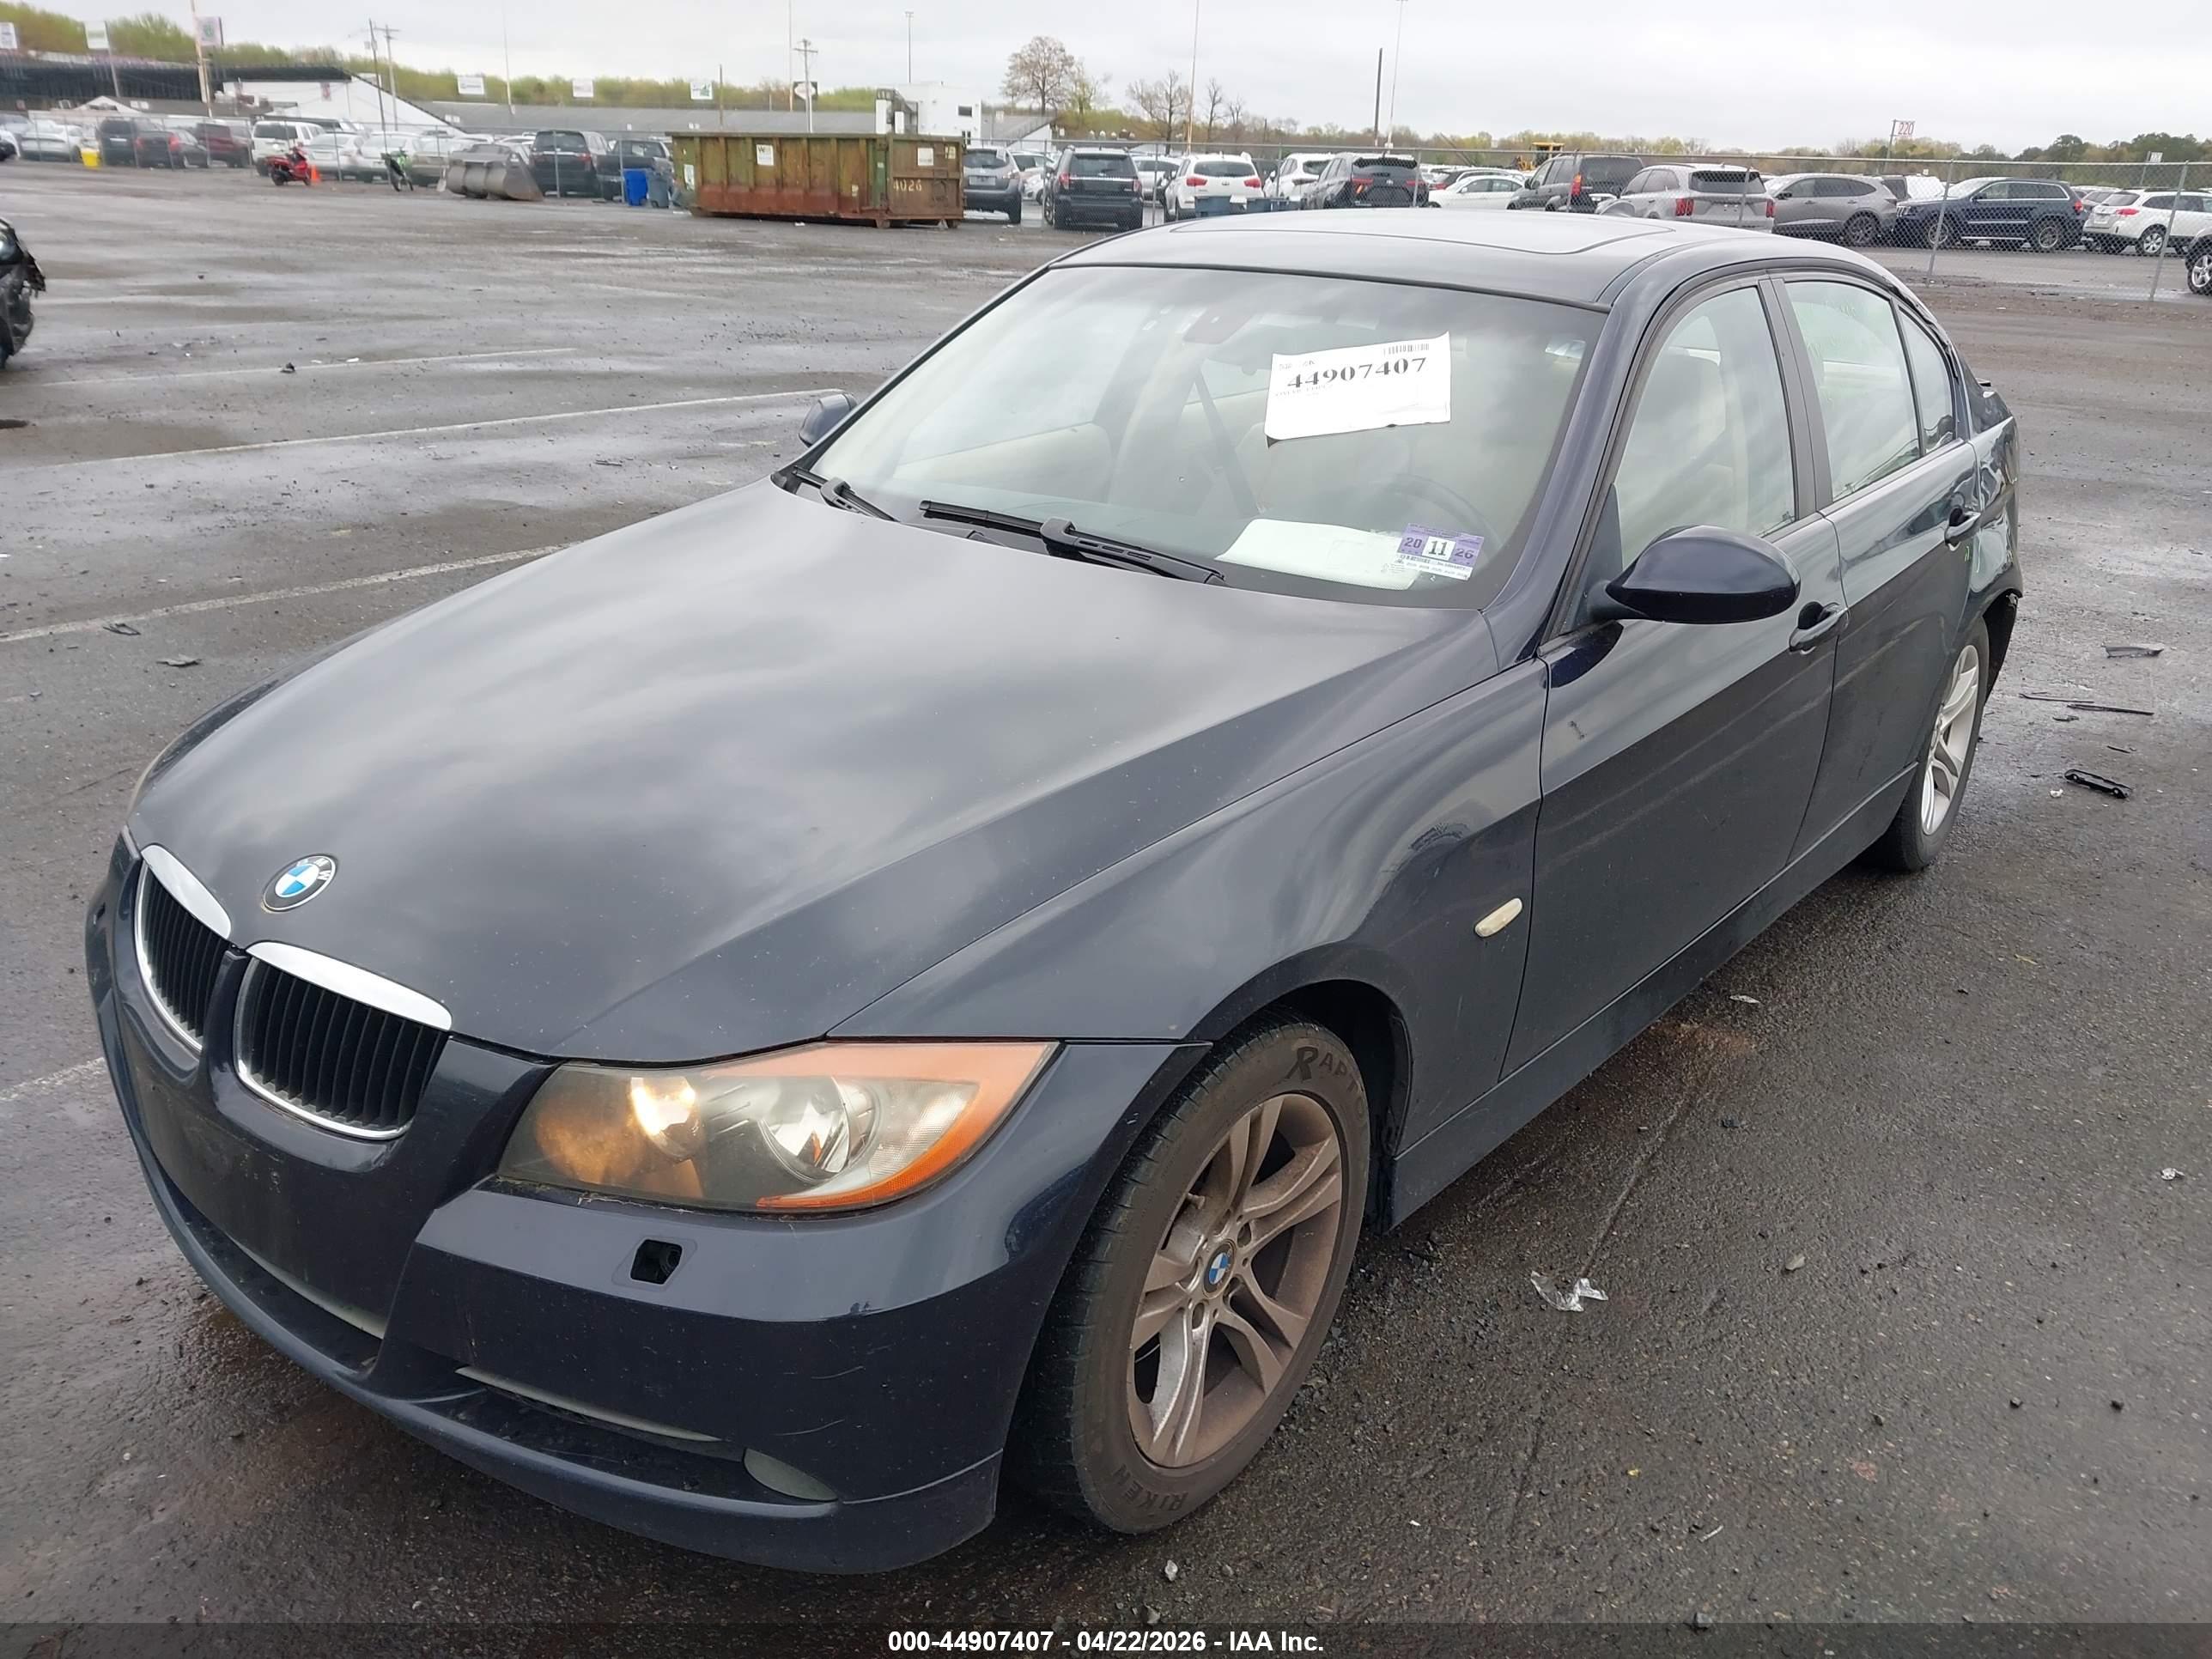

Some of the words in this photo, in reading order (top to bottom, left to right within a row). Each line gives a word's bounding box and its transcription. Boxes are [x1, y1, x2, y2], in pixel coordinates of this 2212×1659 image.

[1898, 121, 1914, 135] 220
[1287, 357, 1426, 388] 44907407
[1405, 537, 1423, 549] 20
[1428, 540, 1448, 556] 11
[1455, 548, 1474, 559] 26
